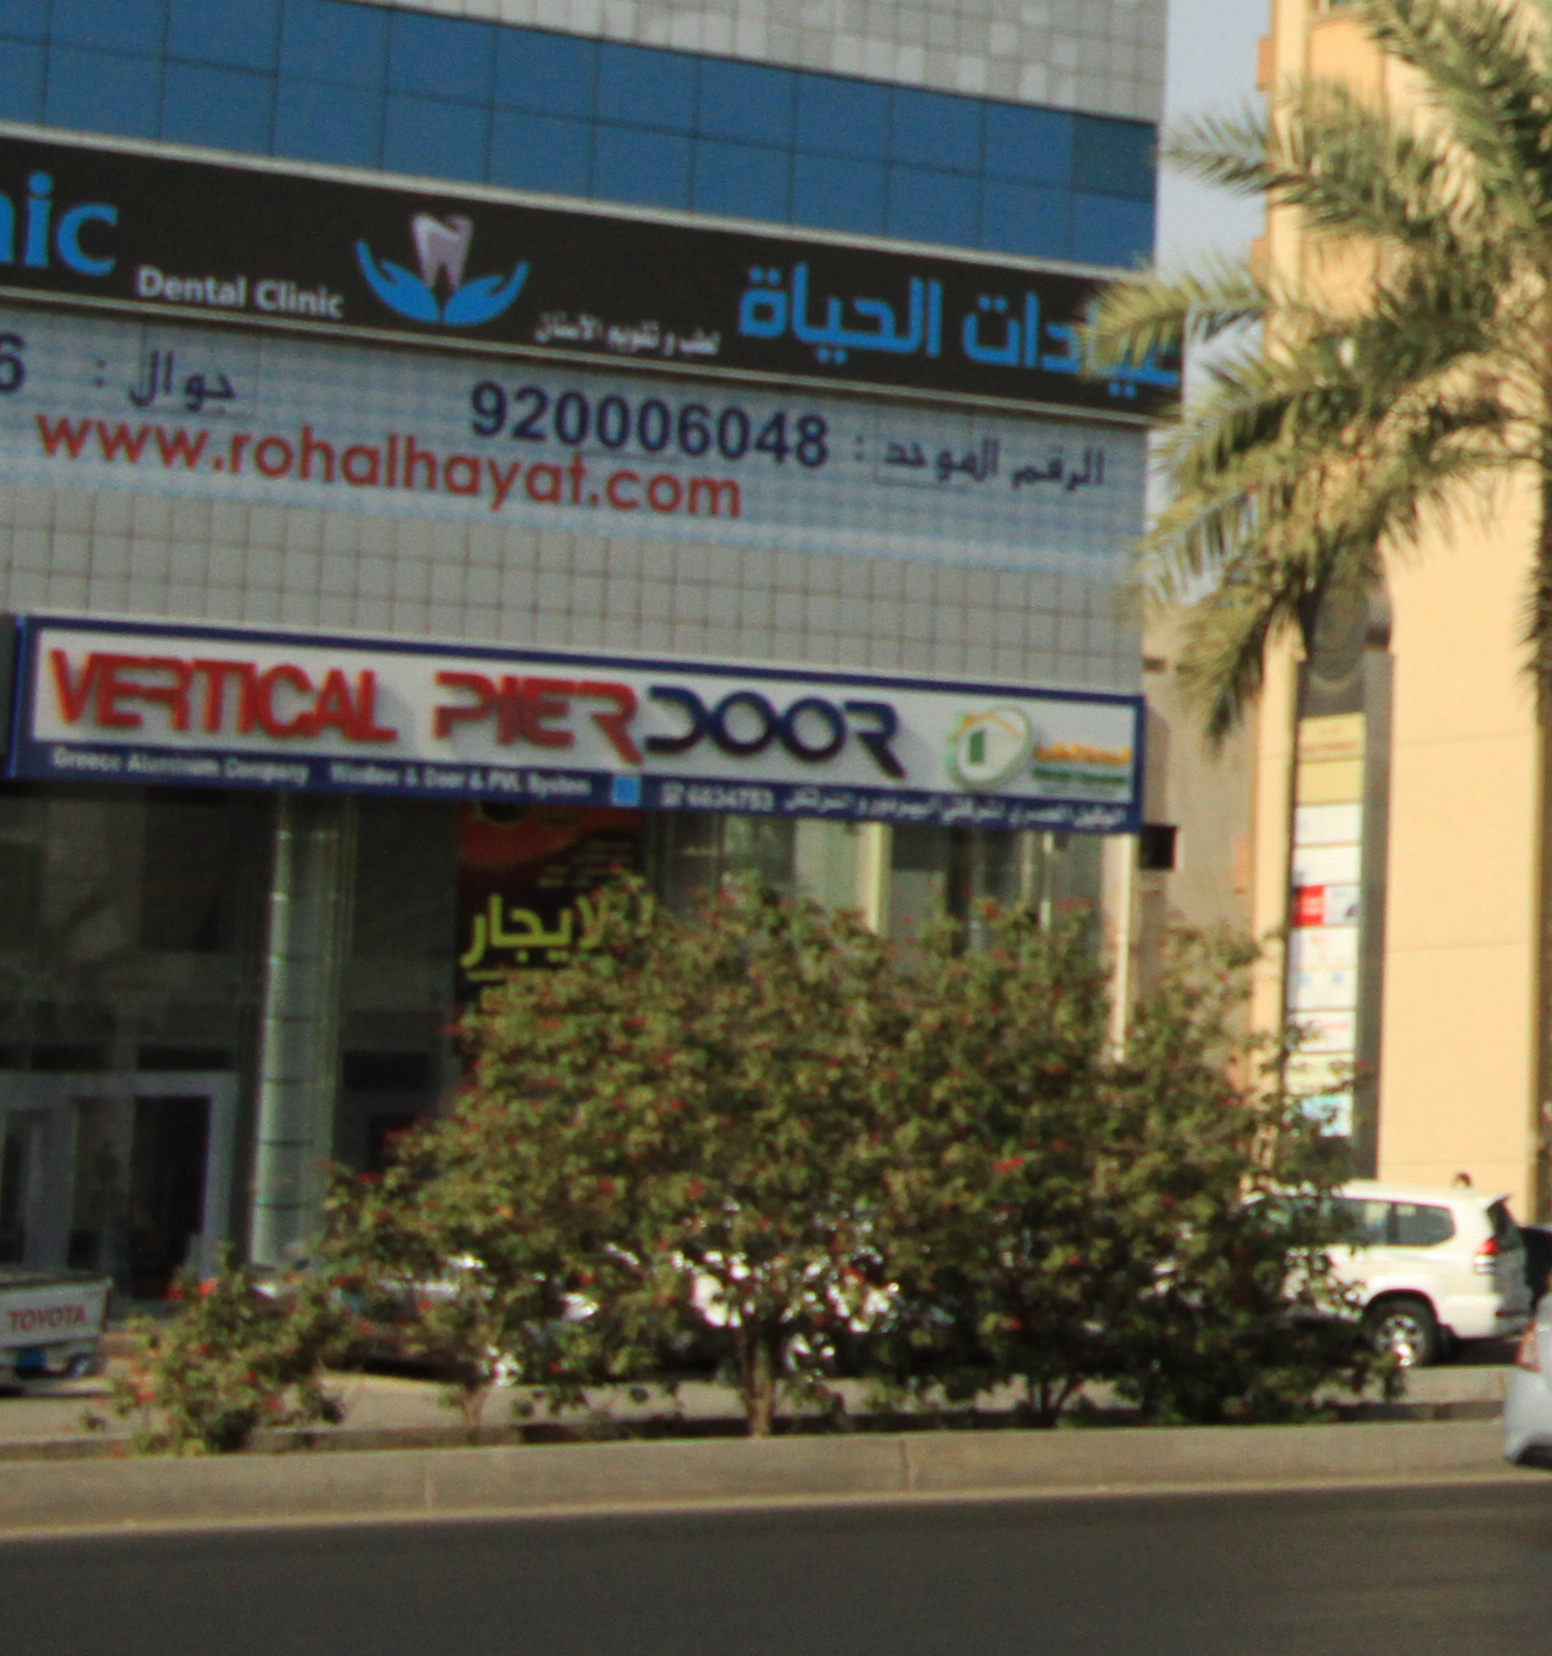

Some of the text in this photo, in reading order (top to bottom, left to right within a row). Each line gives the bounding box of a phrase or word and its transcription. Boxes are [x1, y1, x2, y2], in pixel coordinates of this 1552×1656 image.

[0, 170, 119, 276] ic
[137, 264, 345, 319] Dental Clinic
[738, 261, 943, 366] الحياة
[36, 411, 741, 518] www.rohalhayat.com
[470, 380, 828, 468] 920006048
[49, 647, 398, 744] VERTICAL
[7, 1304, 87, 1333] TOYOTA
